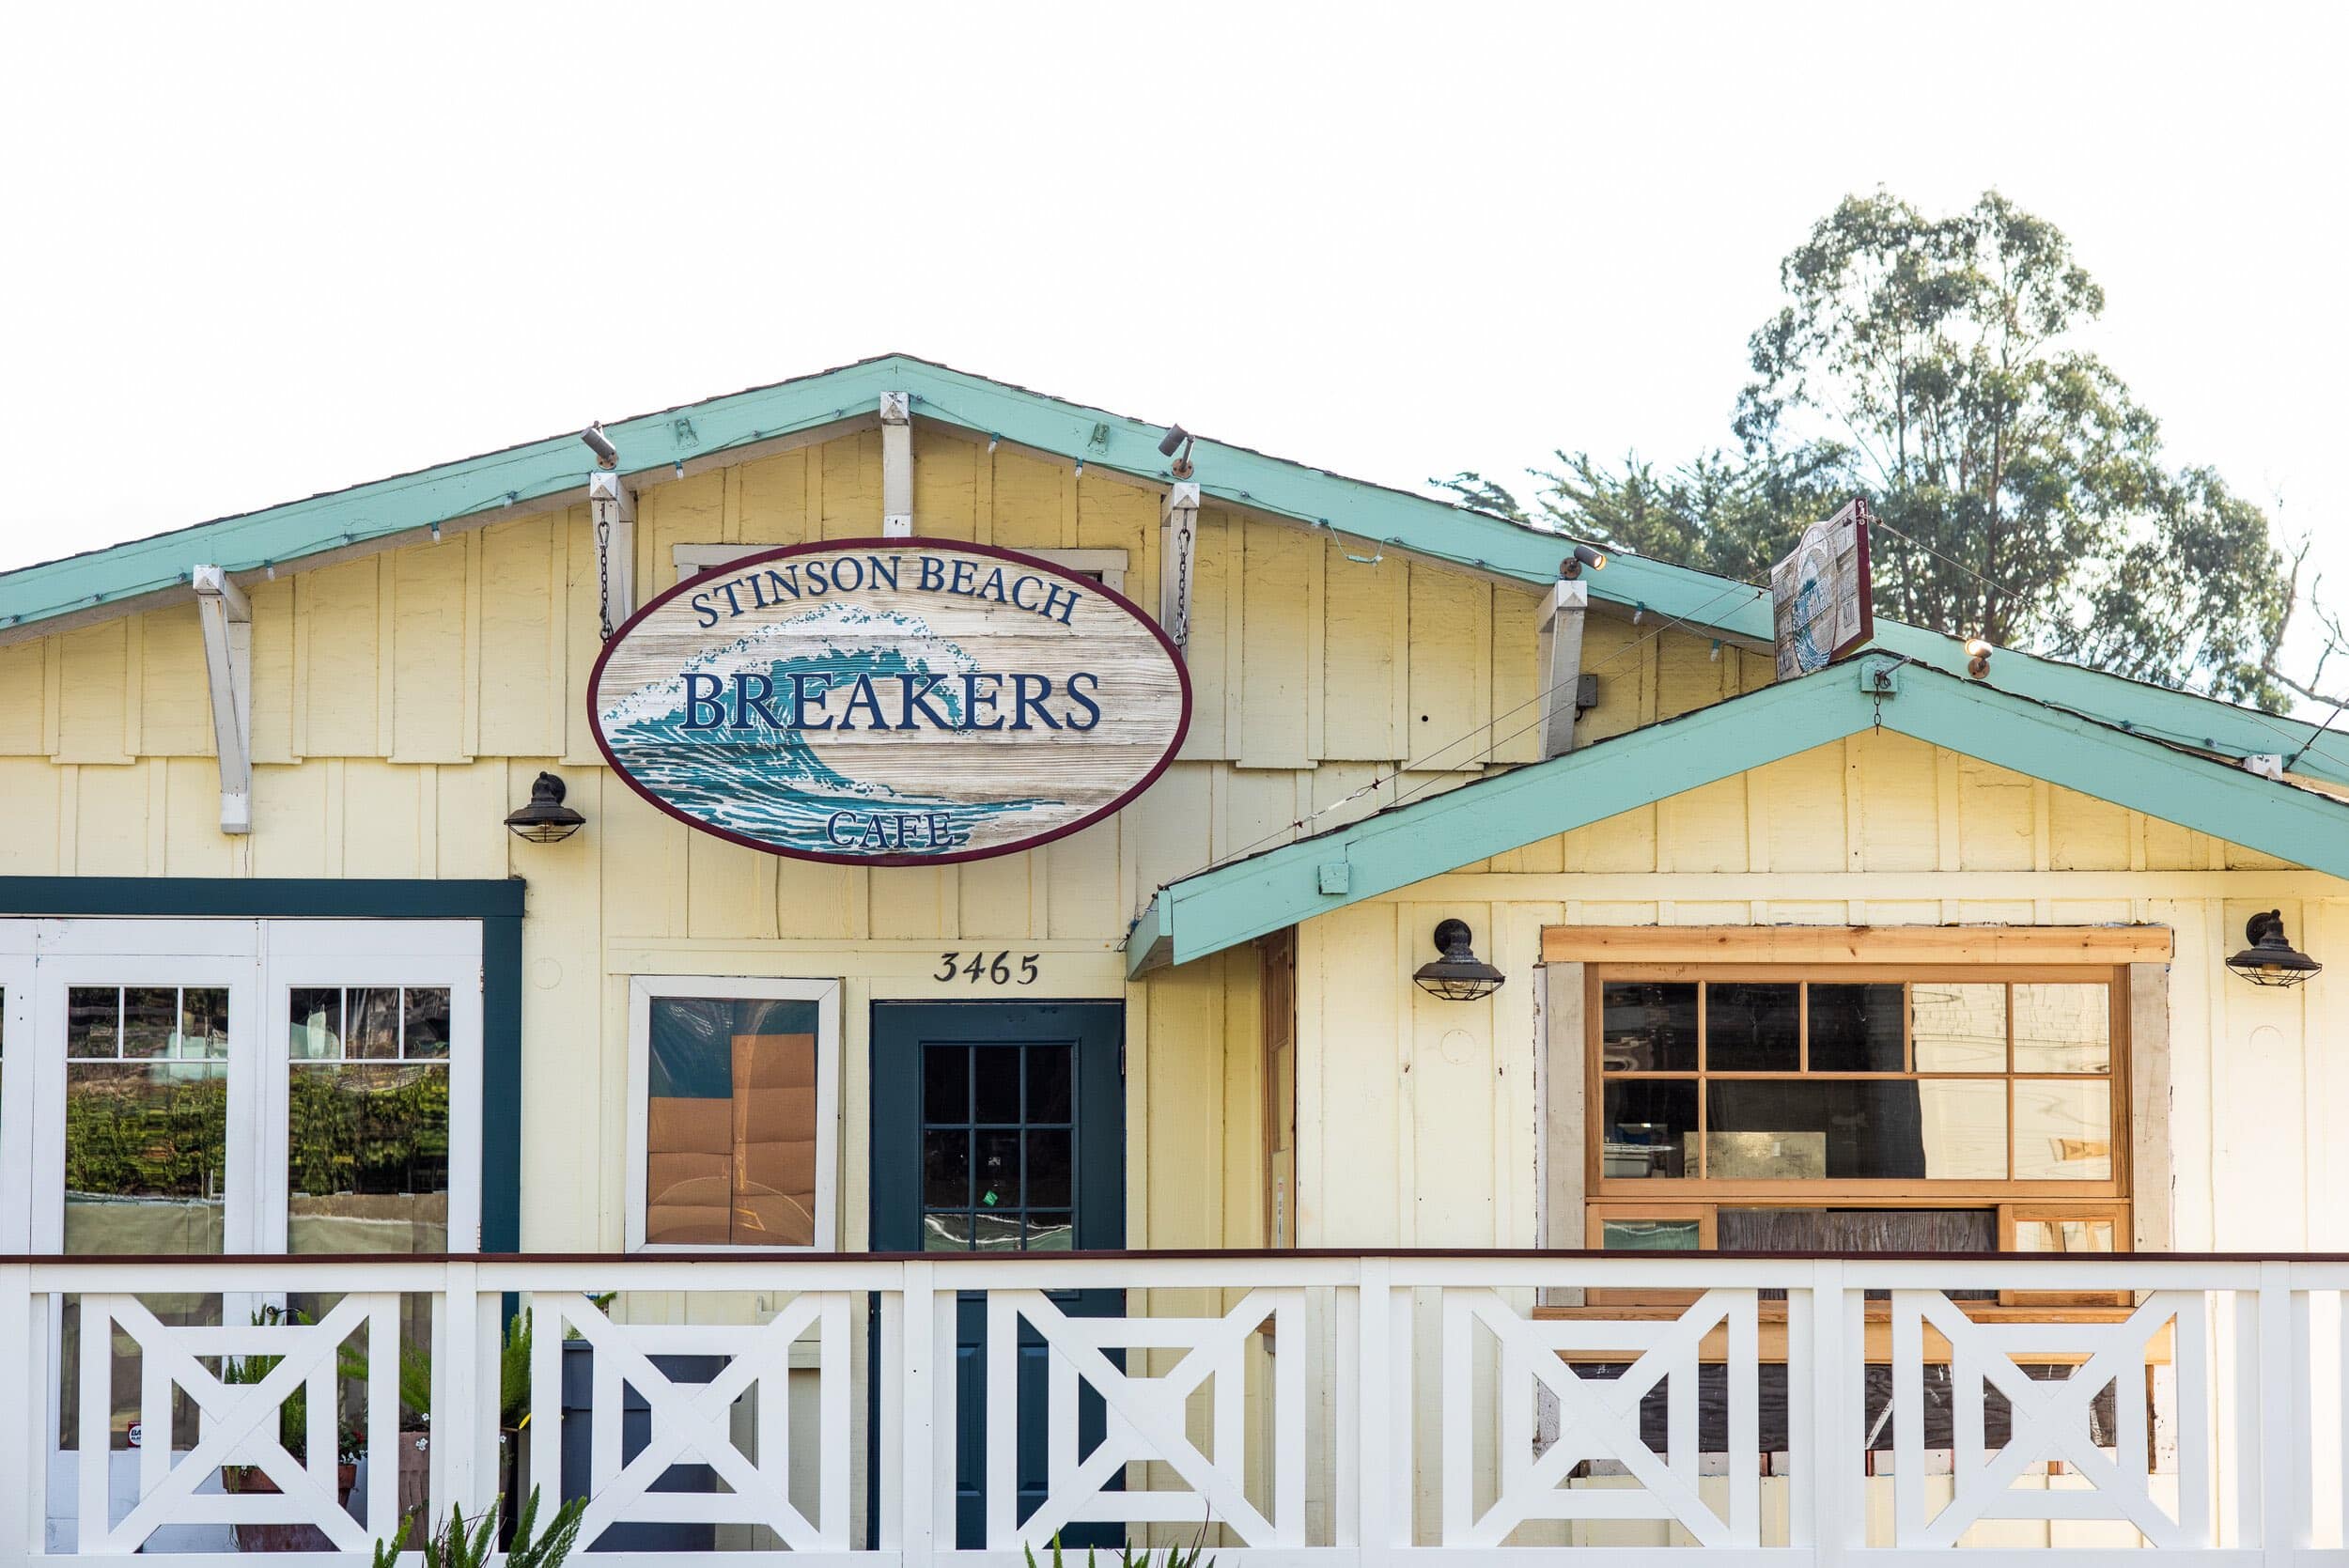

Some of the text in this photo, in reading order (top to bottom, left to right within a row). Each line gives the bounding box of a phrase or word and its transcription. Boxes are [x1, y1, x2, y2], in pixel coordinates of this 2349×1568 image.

[692, 555, 1082, 629] STINSON BEACH
[678, 672, 1101, 731] BREAKERS
[827, 812, 957, 849] CAFE
[933, 950, 1039, 985] 3465
